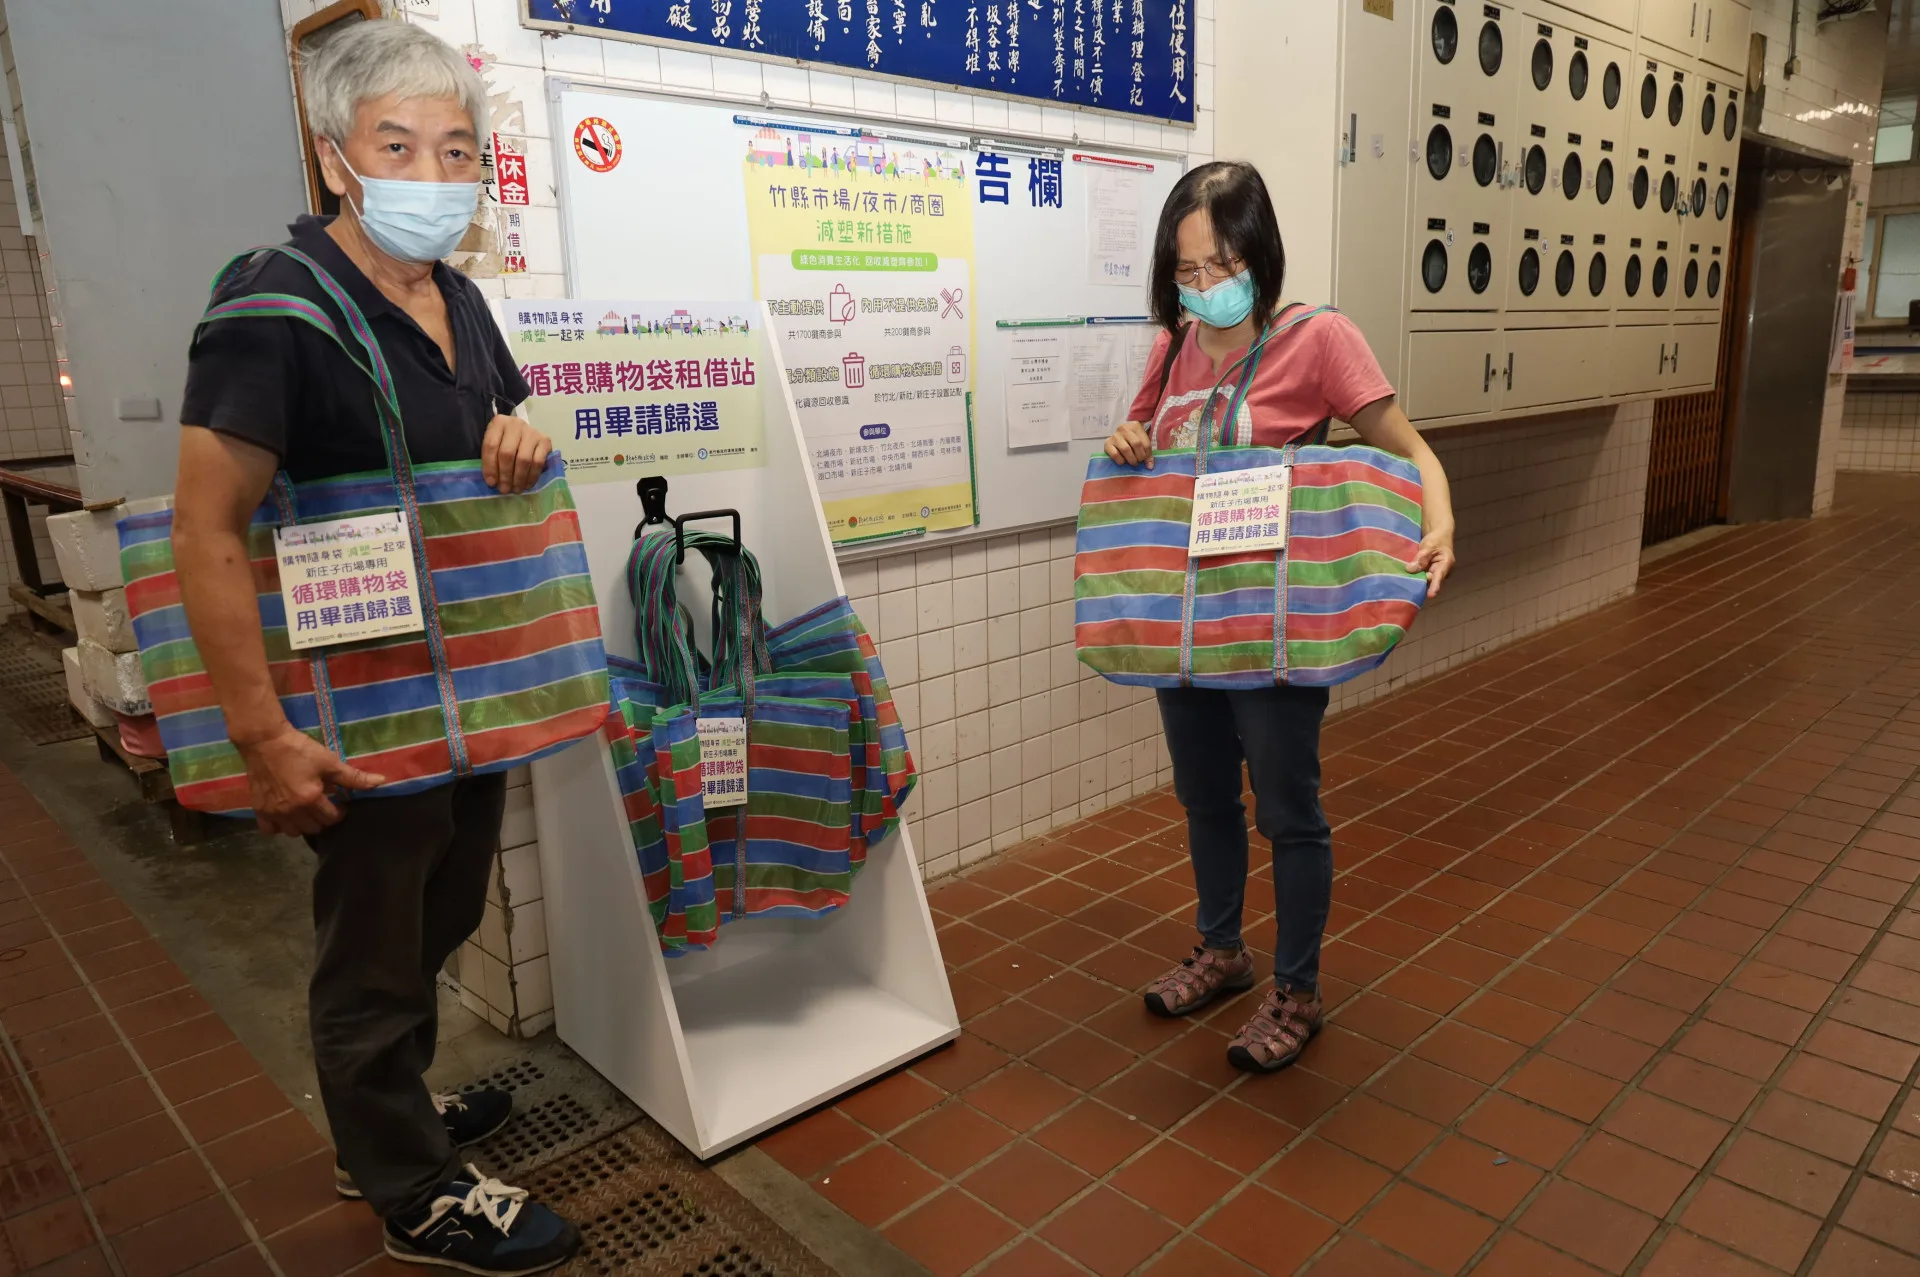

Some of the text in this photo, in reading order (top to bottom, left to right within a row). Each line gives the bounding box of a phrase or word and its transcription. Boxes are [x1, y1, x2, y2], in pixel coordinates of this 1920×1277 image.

[769, 185, 945, 216] 竹縣市場/夜市/商圈
[816, 219, 912, 244] 減塑新措施
[518, 311, 583, 325] 購物隨身袋
[520, 329, 585, 342] 減塑一起來
[521, 356, 756, 397] 循環購物袋租借站
[869, 361, 943, 380] 循環購物袋租借
[575, 401, 720, 440] 用畢請歸還
[1197, 504, 1280, 526] 循環購物袋
[1195, 522, 1279, 544] 用畢請歸還
[305, 557, 388, 578] 新庄子市場專用
[291, 569, 408, 605] 循環購物袋
[297, 596, 413, 631] 用畢請歸還
